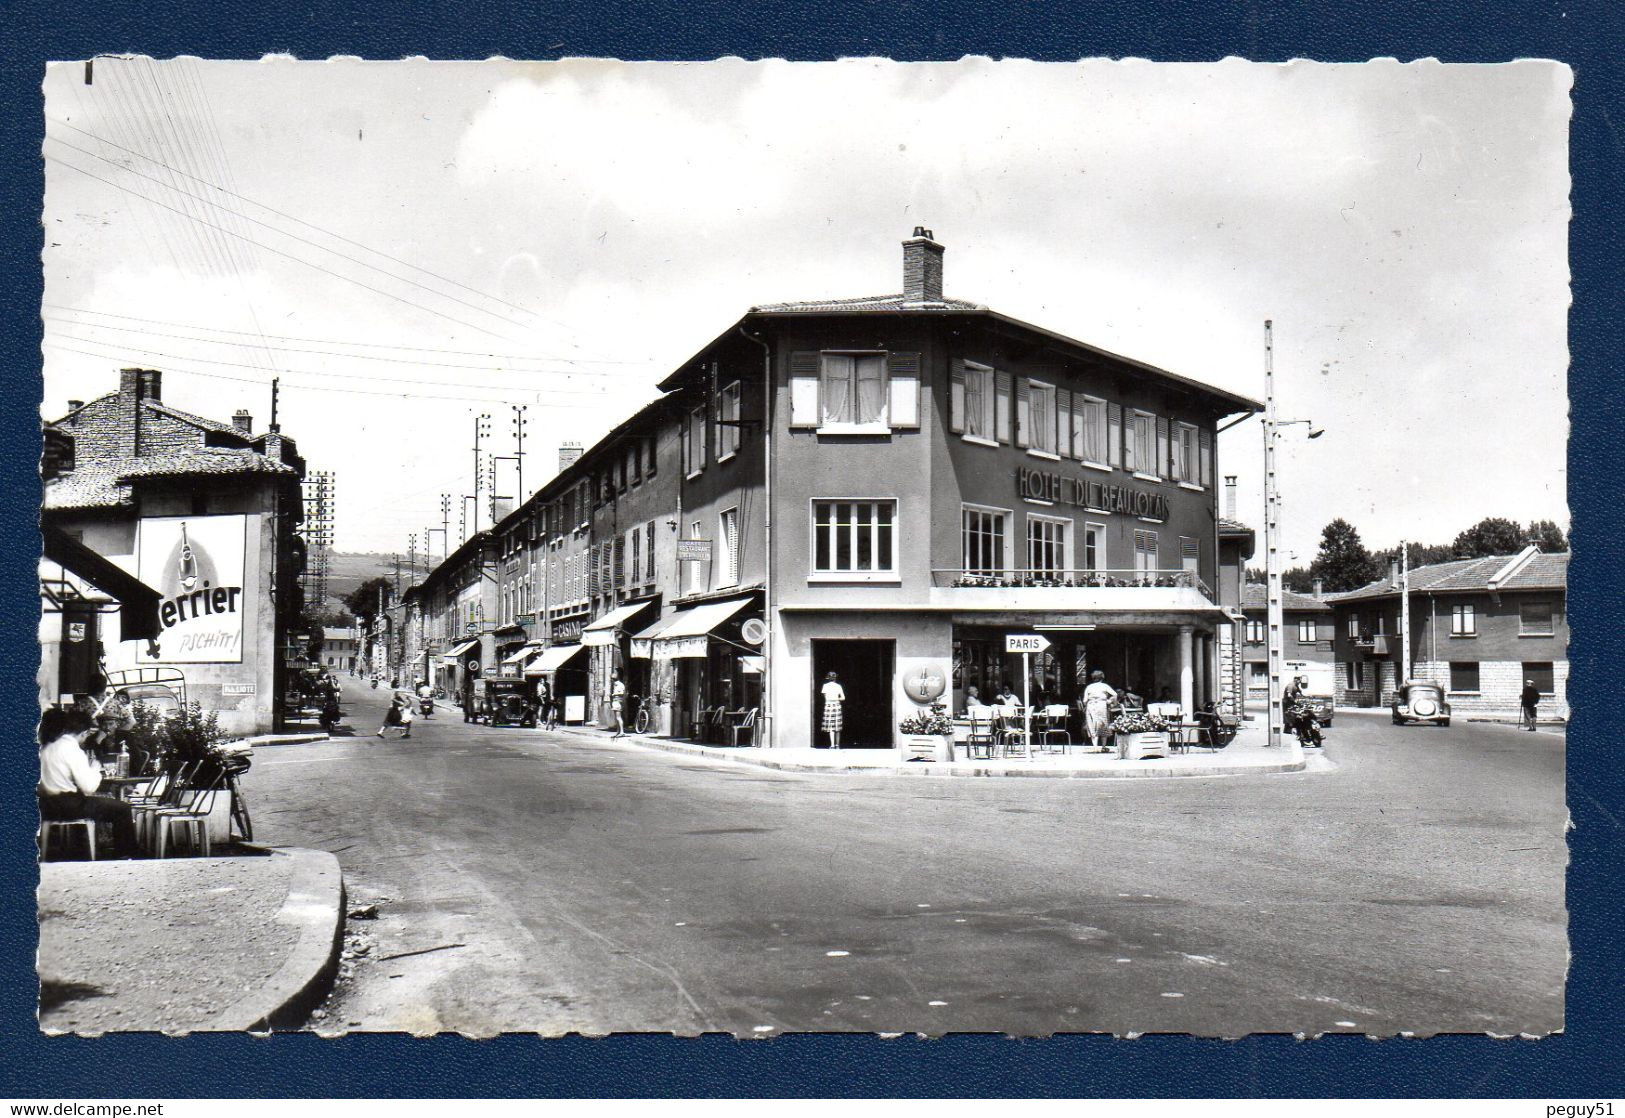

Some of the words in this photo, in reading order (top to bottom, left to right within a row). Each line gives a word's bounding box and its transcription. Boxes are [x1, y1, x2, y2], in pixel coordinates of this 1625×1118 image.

[1018, 466, 1064, 503] HOTEL
[1076, 479, 1092, 507] DU
[1101, 483, 1170, 520] BEAUJOLAIS
[159, 580, 241, 630] errier
[558, 620, 581, 638] CASINO
[1009, 638, 1040, 649] PARIS
